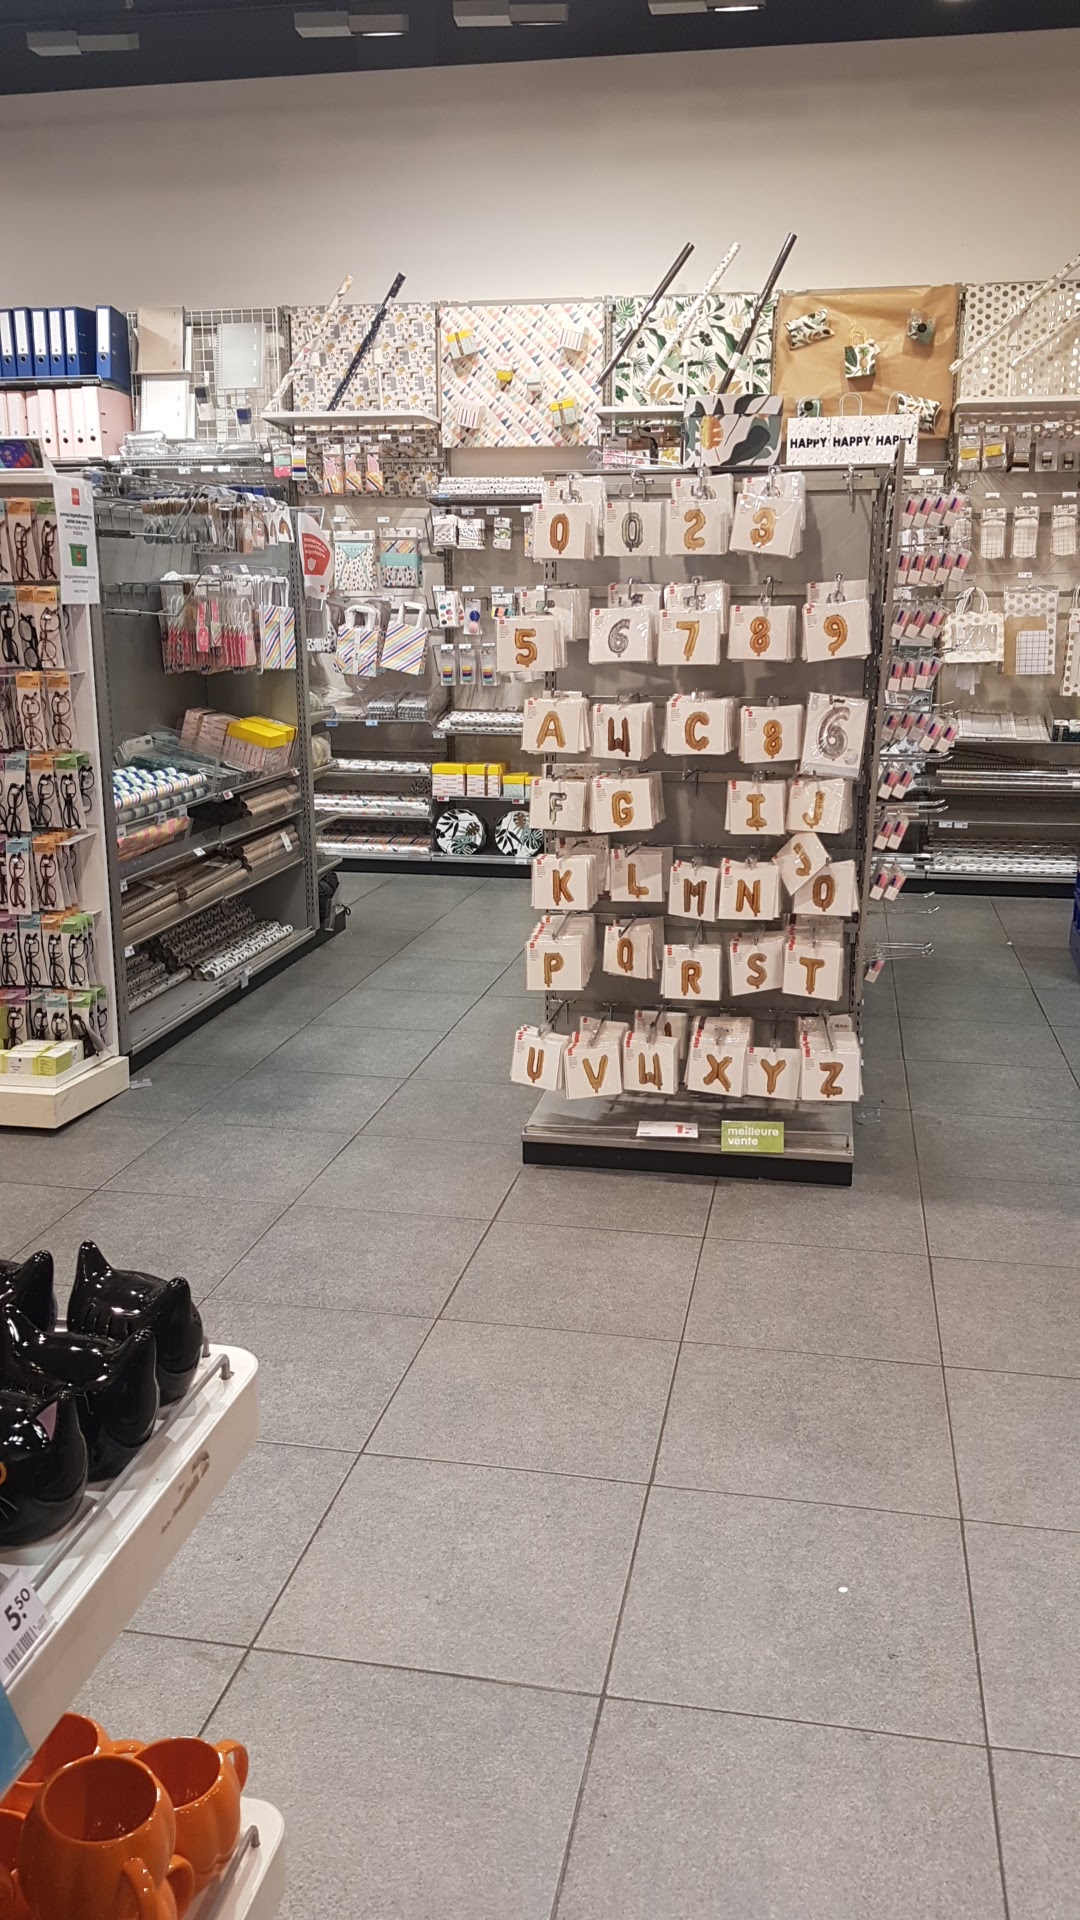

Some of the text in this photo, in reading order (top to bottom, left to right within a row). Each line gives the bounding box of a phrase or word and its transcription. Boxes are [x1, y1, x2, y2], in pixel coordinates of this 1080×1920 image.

[790, 436, 827, 449] HAPPY
[833, 435, 871, 447] HAPPY
[683, 508, 707, 551] 2
[749, 506, 777, 548] 3
[515, 628, 538, 668] 5
[607, 618, 631, 658] 6
[676, 620, 700, 661] 7
[749, 616, 771, 657] 8
[823, 613, 848, 656] 9
[536, 710, 566, 748] A
[684, 711, 710, 752] C
[763, 719, 783, 759] 8
[817, 705, 851, 762] 6
[548, 791, 568, 825] F
[611, 790, 634, 829] G
[746, 793, 767, 832] I
[801, 790, 826, 829] J
[792, 841, 811, 877] J
[552, 869, 574, 906] K
[627, 862, 650, 899] L
[683, 878, 708, 917] M
[736, 879, 762, 917] N
[543, 952, 565, 988] P
[681, 959, 703, 996] R
[746, 952, 768, 990] S
[799, 956, 826, 995] T
[527, 1047, 545, 1083] U
[582, 1054, 609, 1094] V
[638, 1052, 663, 1091] W
[703, 1054, 733, 1092] X
[761, 1058, 787, 1095] Y
[819, 1062, 844, 1099] Z
[727, 1136, 759, 1146] vente
[728, 1125, 779, 1137] meilleure
